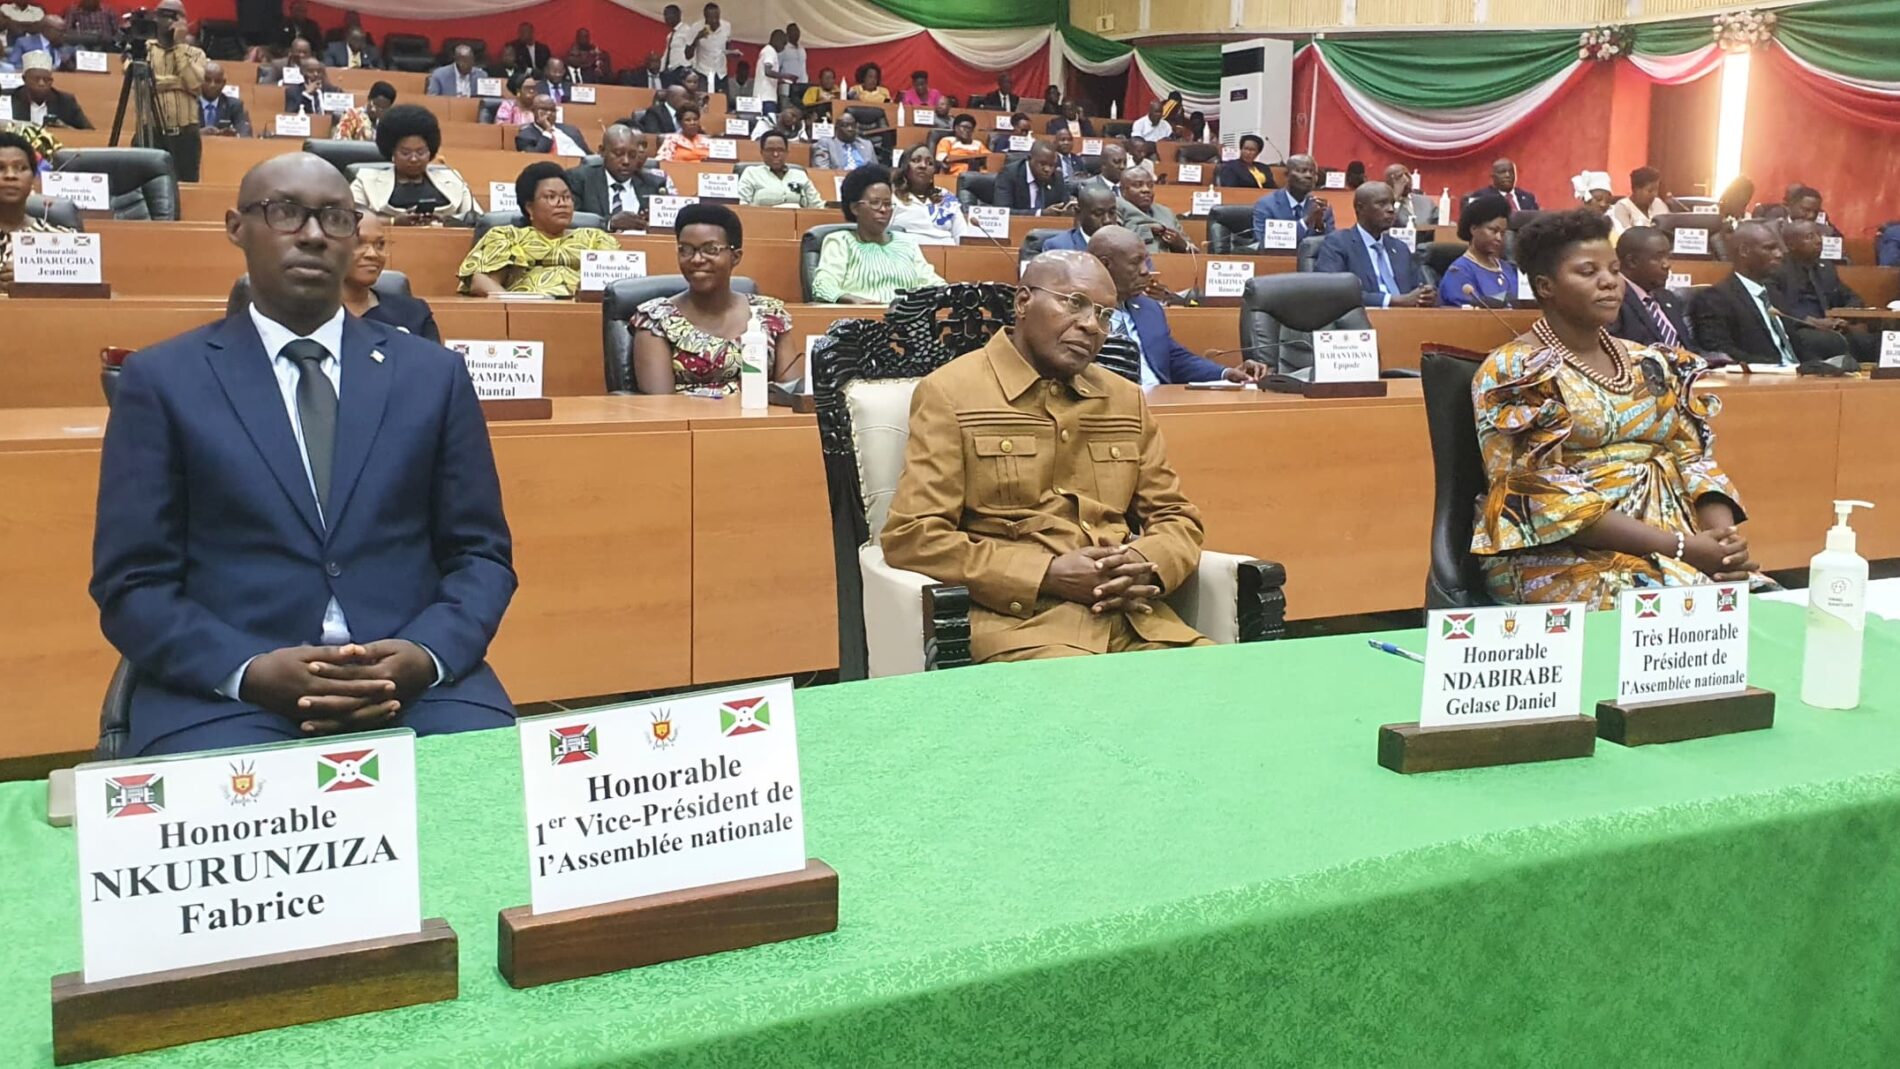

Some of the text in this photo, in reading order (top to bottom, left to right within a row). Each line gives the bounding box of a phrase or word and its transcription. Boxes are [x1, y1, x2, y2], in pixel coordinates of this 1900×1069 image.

[20, 256, 95, 266] HABARUGIRA
[35, 247, 79, 256] Honorable
[37, 266, 79, 277] Jeanine
[466, 359, 519, 370] Honorable
[471, 371, 535, 384] RAMPAMA
[476, 385, 516, 397] hantal
[1633, 622, 1739, 648] Très Honorable
[1463, 642, 1548, 664] Honorable
[1643, 648, 1728, 672] Président de
[1442, 665, 1563, 691] NDABIRABE
[1621, 670, 1745, 696] l’Assemblée nationale
[1446, 691, 1557, 716] Gelase Daniel
[587, 754, 743, 803] Honorable
[535, 781, 795, 847] 1er Vice-Président de
[158, 804, 338, 850] Honorable
[538, 811, 794, 878] l’Assemblée nationale
[90, 834, 399, 903] NKURUNZIZA
[179, 891, 326, 935] Fabrice
